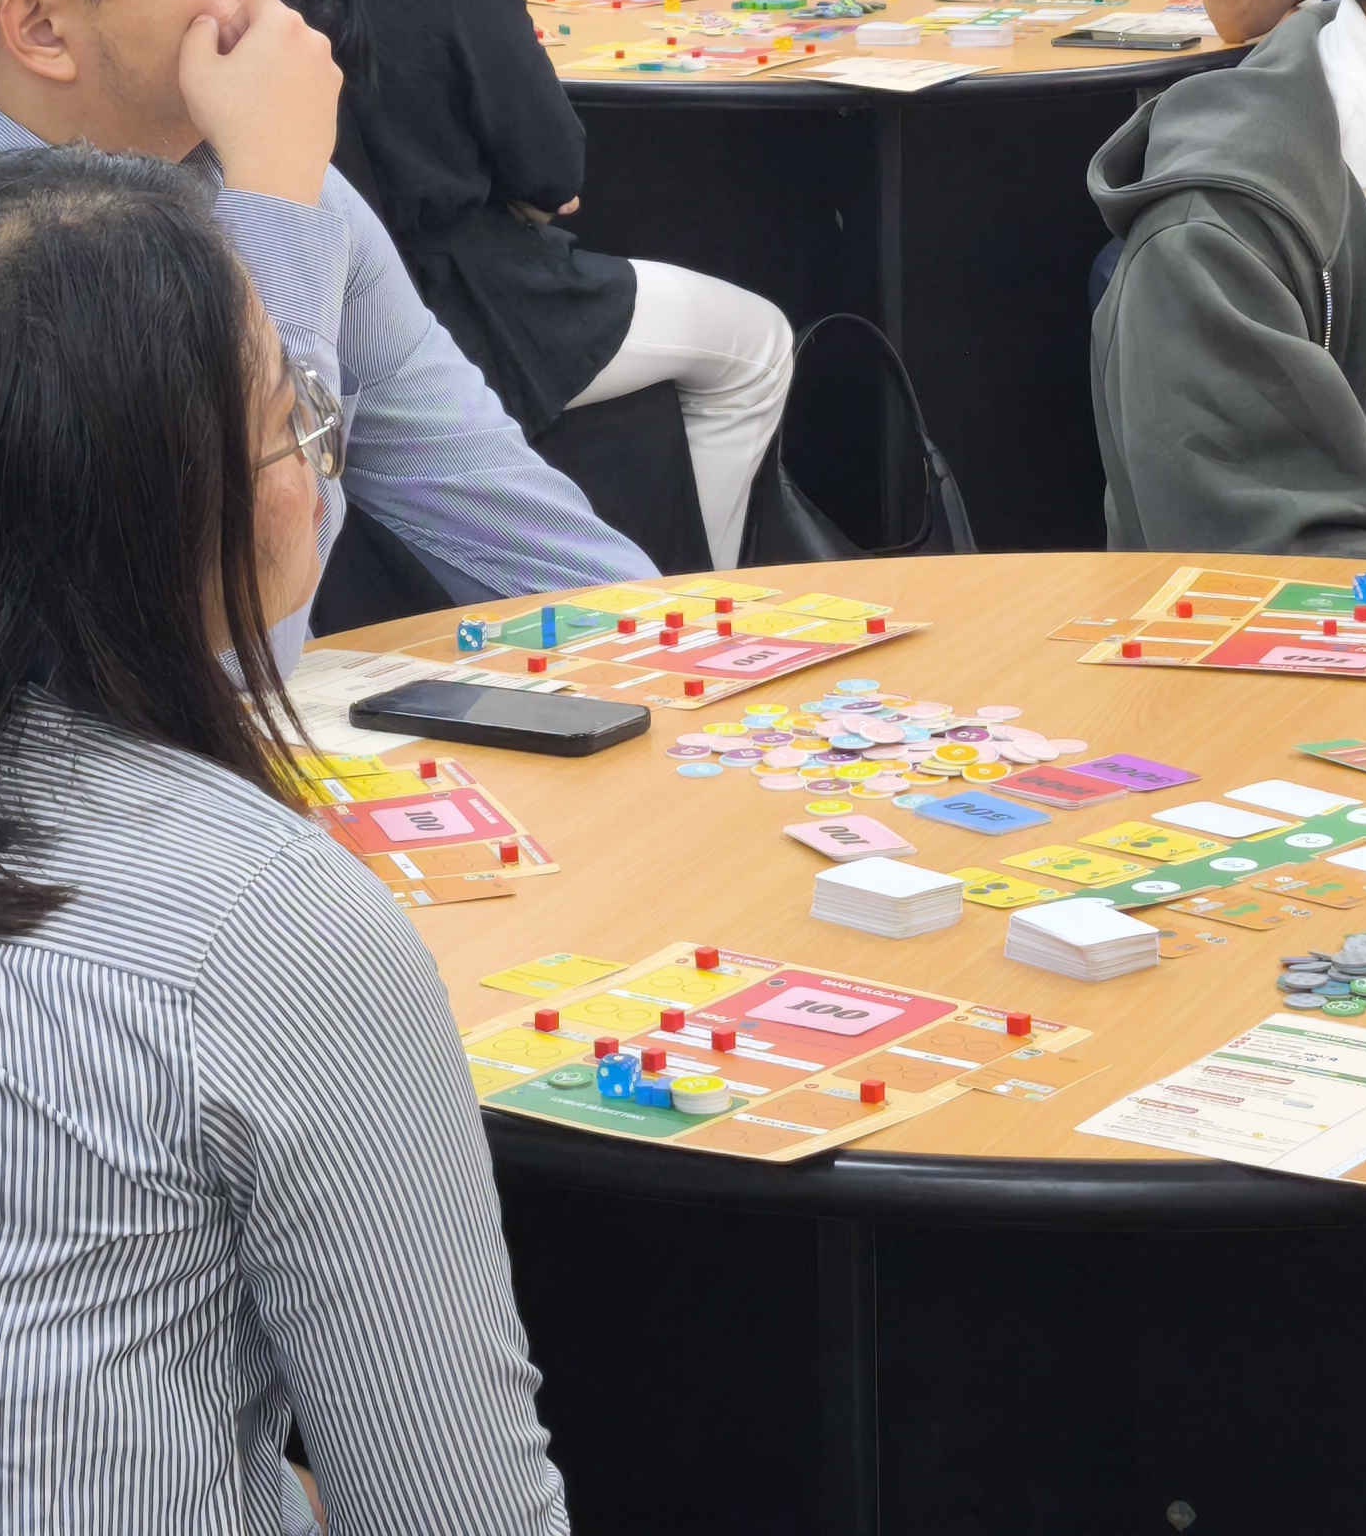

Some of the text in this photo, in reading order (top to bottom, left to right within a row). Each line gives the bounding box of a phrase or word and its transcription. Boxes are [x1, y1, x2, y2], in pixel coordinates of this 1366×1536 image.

[732, 649, 780, 666] 100
[404, 810, 445, 832] 100
[943, 801, 1015, 823] 500
[817, 824, 871, 846] 100
[784, 999, 870, 1020] 100
